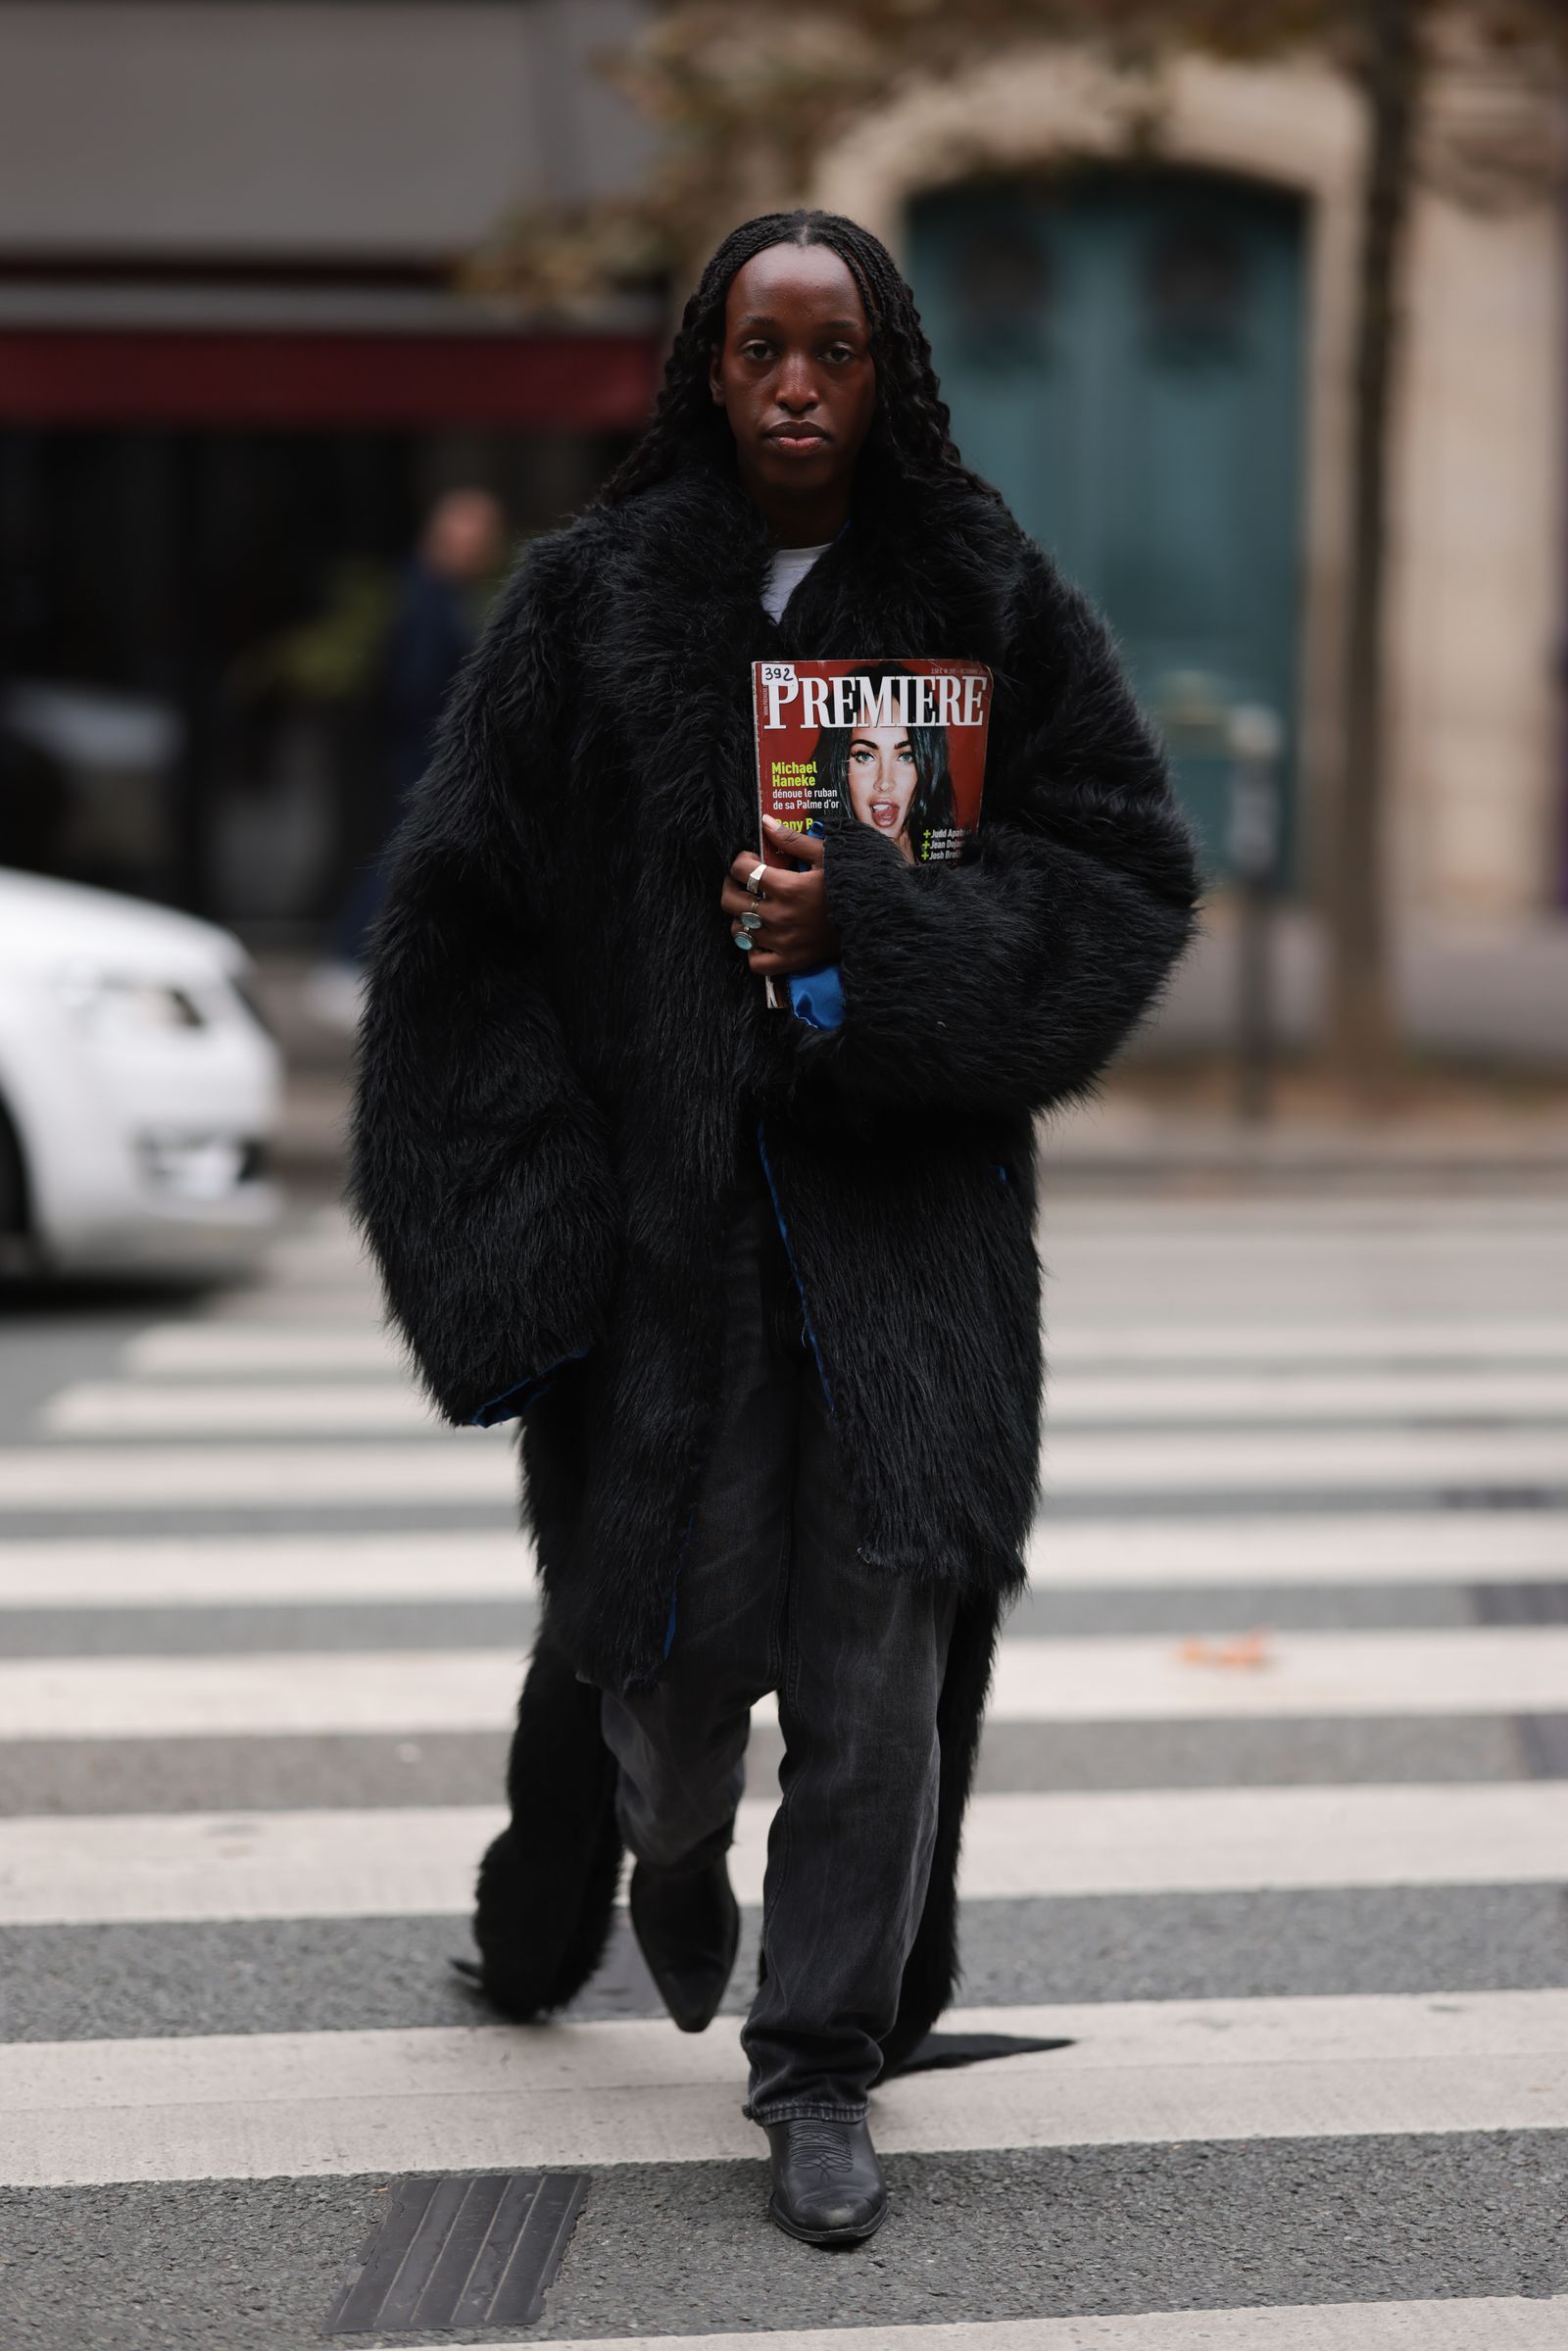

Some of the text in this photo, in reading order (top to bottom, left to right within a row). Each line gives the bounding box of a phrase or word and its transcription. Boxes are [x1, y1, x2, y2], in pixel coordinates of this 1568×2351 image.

[764, 666, 794, 682] 392
[763, 675, 988, 729] PREMIERE
[771, 761, 817, 774] Michael
[771, 774, 815, 787] Haneke
[772, 788, 837, 799] dénoue le ruban
[773, 801, 783, 810] de
[797, 800, 822, 809] Palme
[824, 800, 839, 808] d'or
[931, 829, 947, 838] Judd
[930, 840, 946, 850] Jean
[929, 851, 944, 859] Josh
